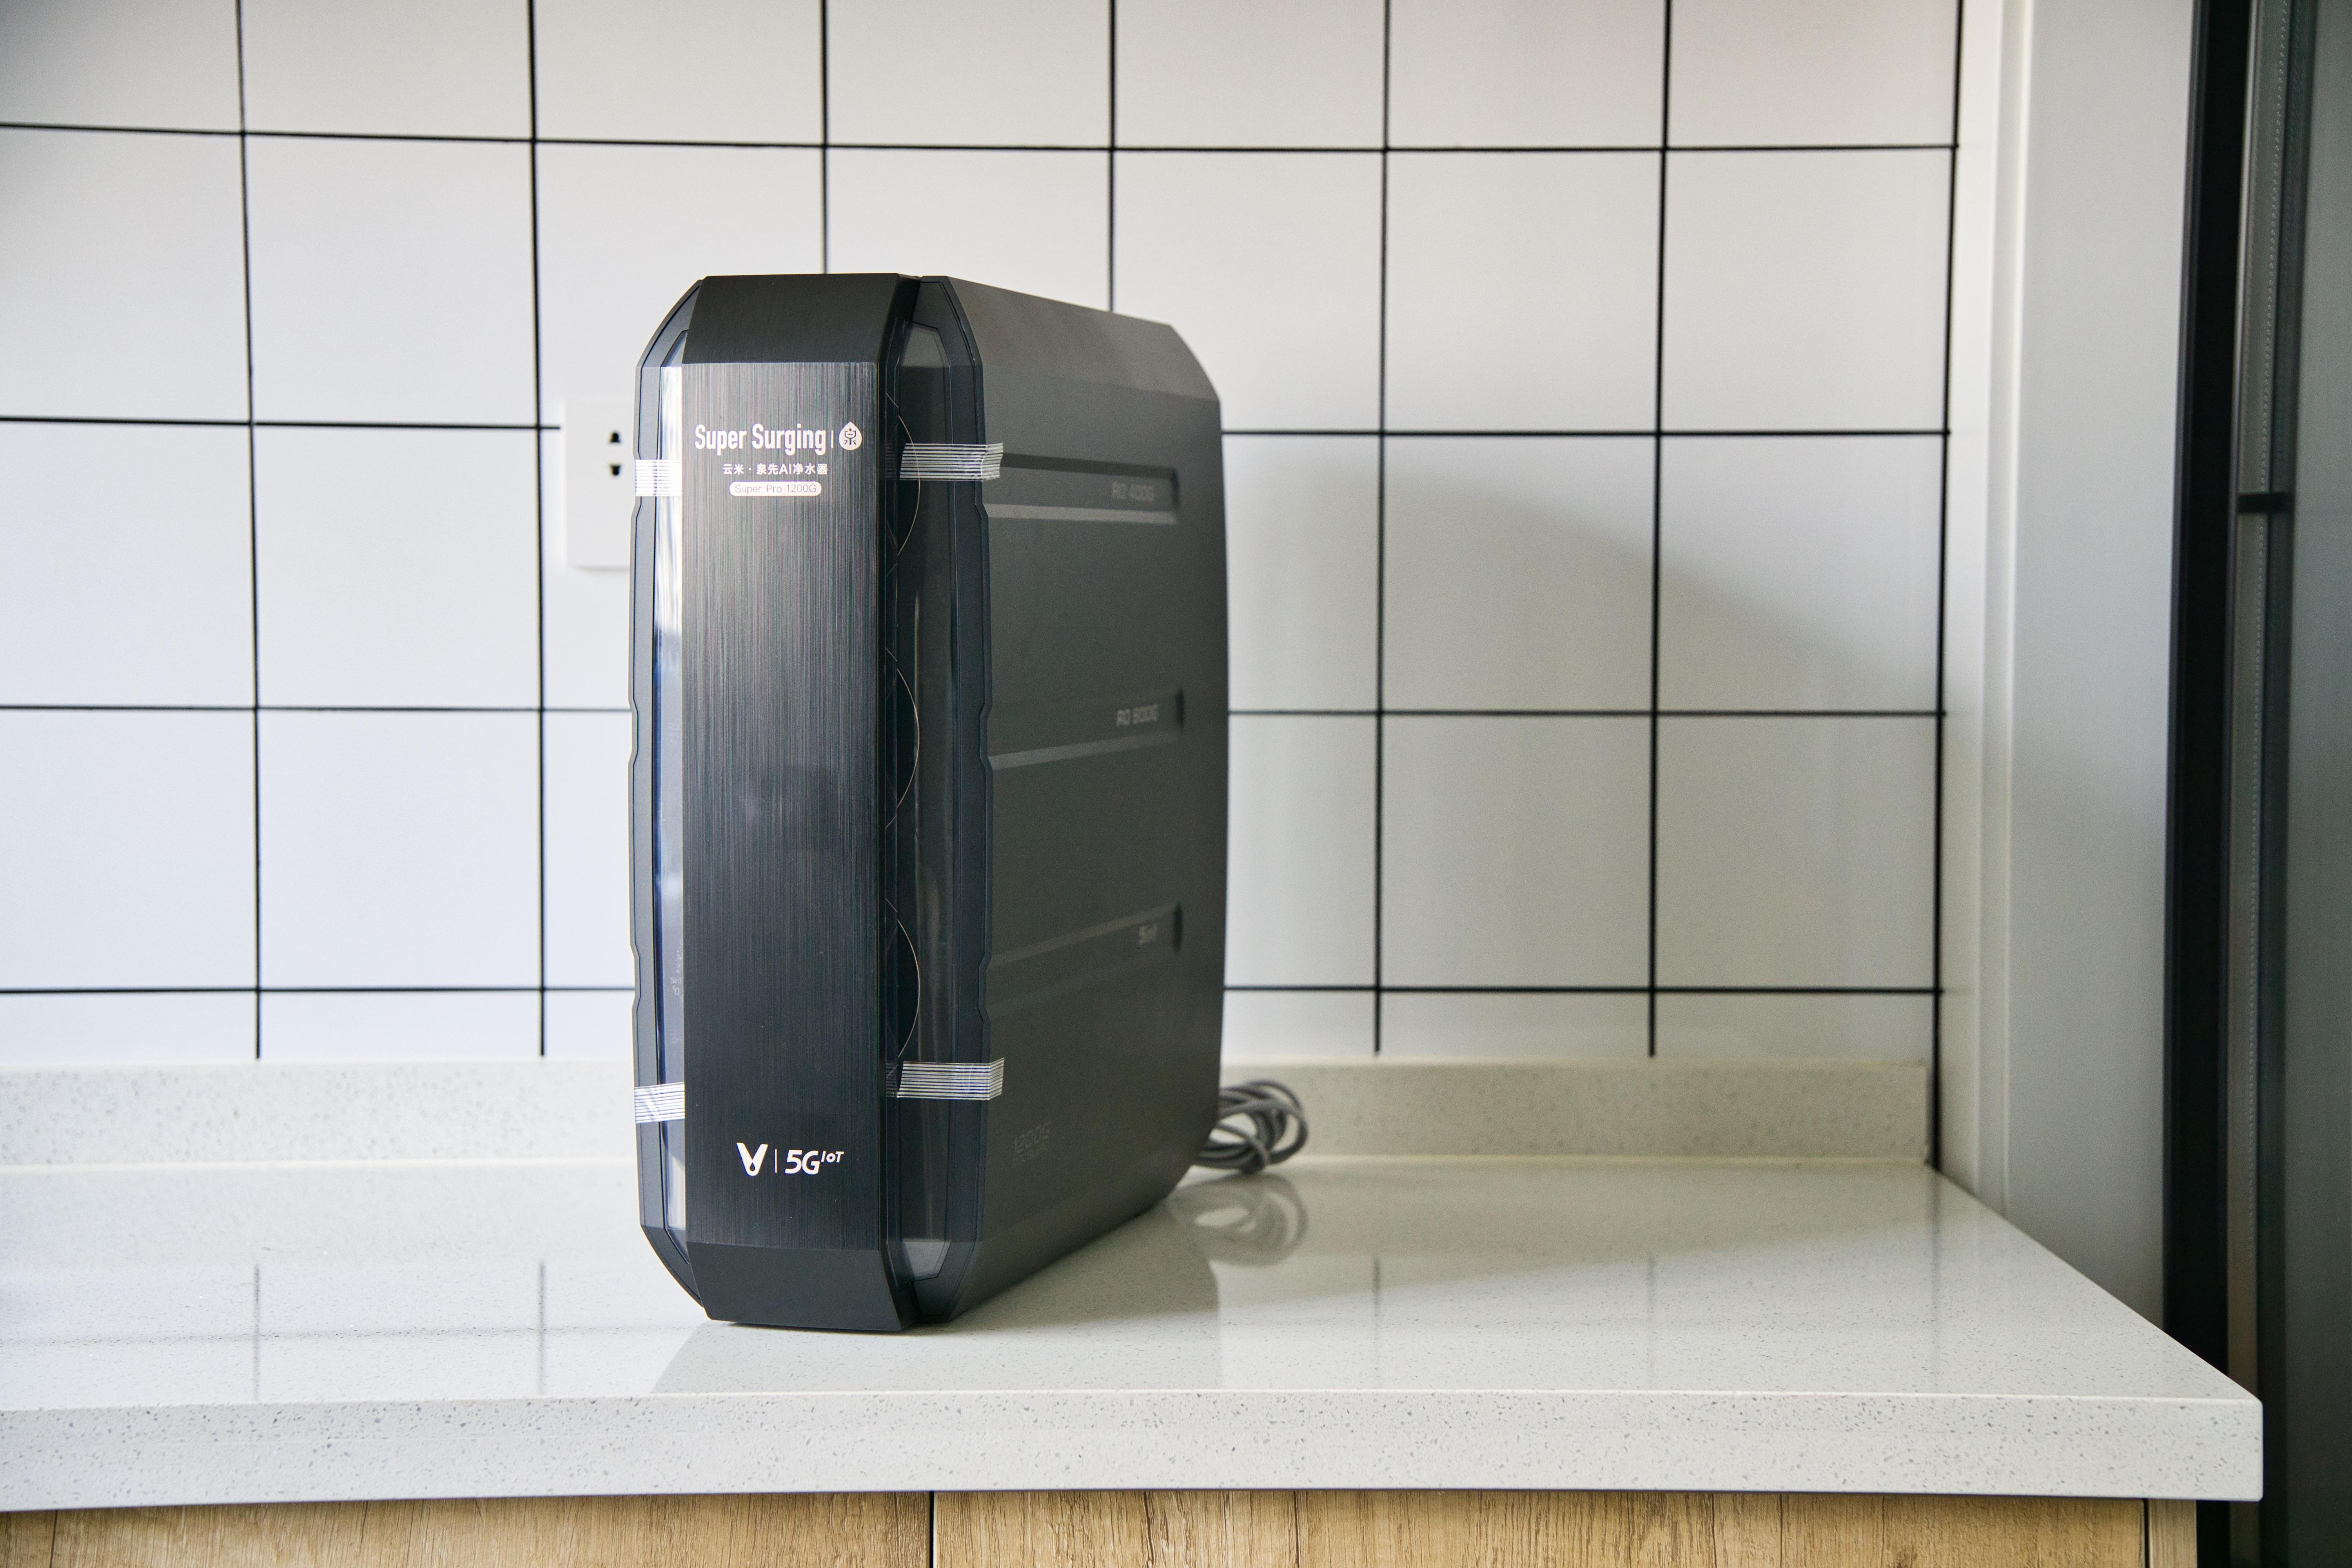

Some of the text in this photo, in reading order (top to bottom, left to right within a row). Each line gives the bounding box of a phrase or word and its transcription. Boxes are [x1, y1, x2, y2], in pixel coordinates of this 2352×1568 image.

[695, 423, 826, 456] Super Surging
[735, 484, 817, 494] Super Pro 1200G
